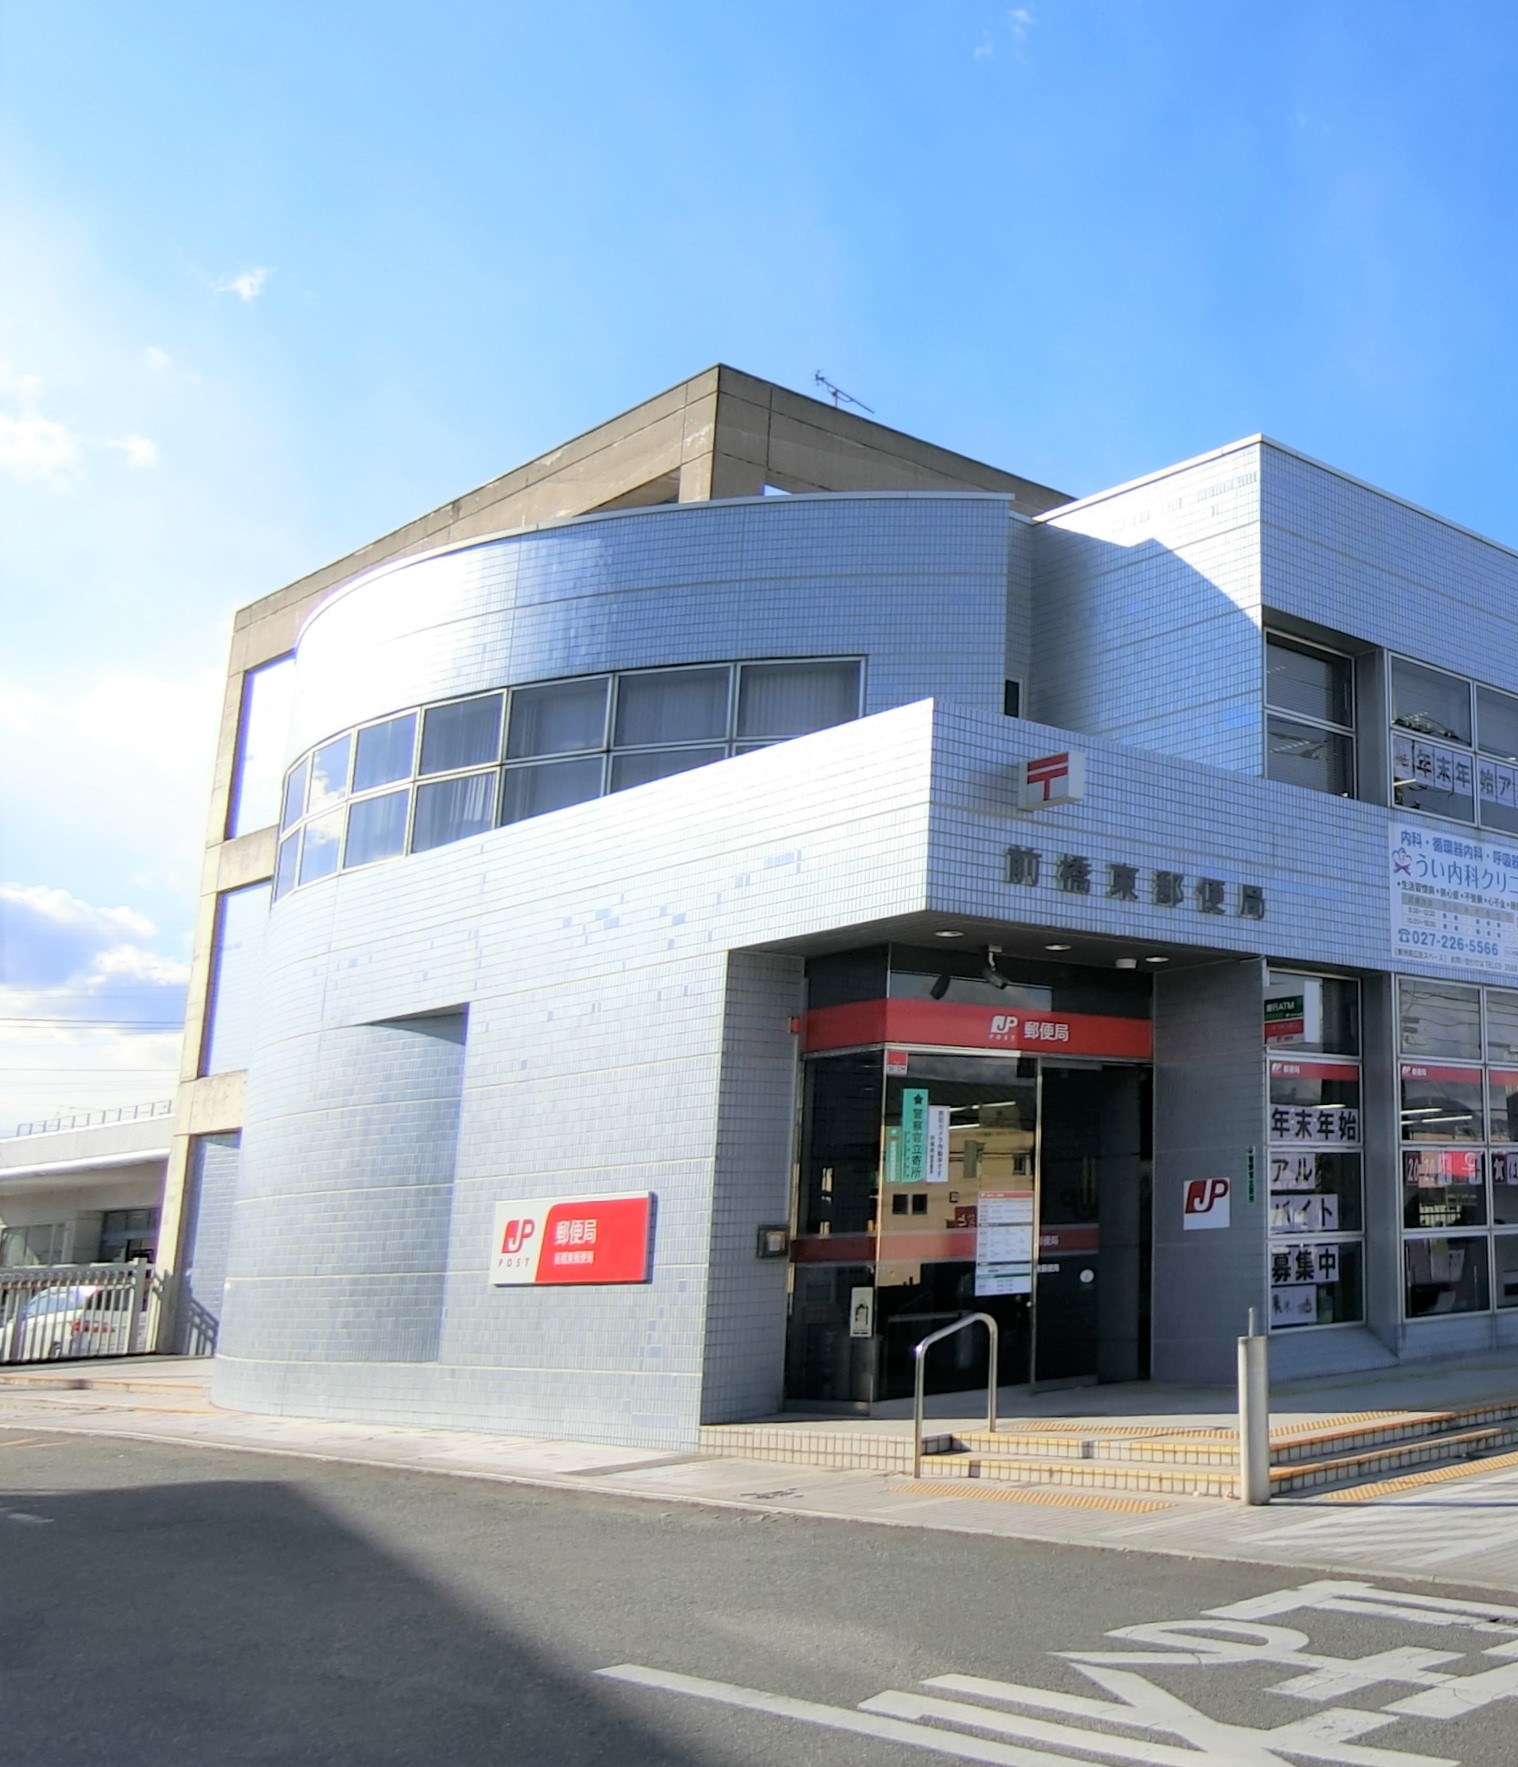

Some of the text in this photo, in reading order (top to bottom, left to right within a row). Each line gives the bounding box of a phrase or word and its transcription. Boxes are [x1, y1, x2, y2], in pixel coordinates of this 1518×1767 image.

[1004, 843, 1266, 921] 前橋東郵便局
[1024, 1021, 1070, 1041] 郵便局
[1271, 1107, 1357, 1141] 年末年始
[911, 1108, 923, 1178] 警察官立寄所
[1271, 1157, 1314, 1184] アル
[554, 1218, 597, 1246] 郵便局
[498, 1257, 531, 1268] POST
[1271, 1247, 1337, 1284] 募集中
